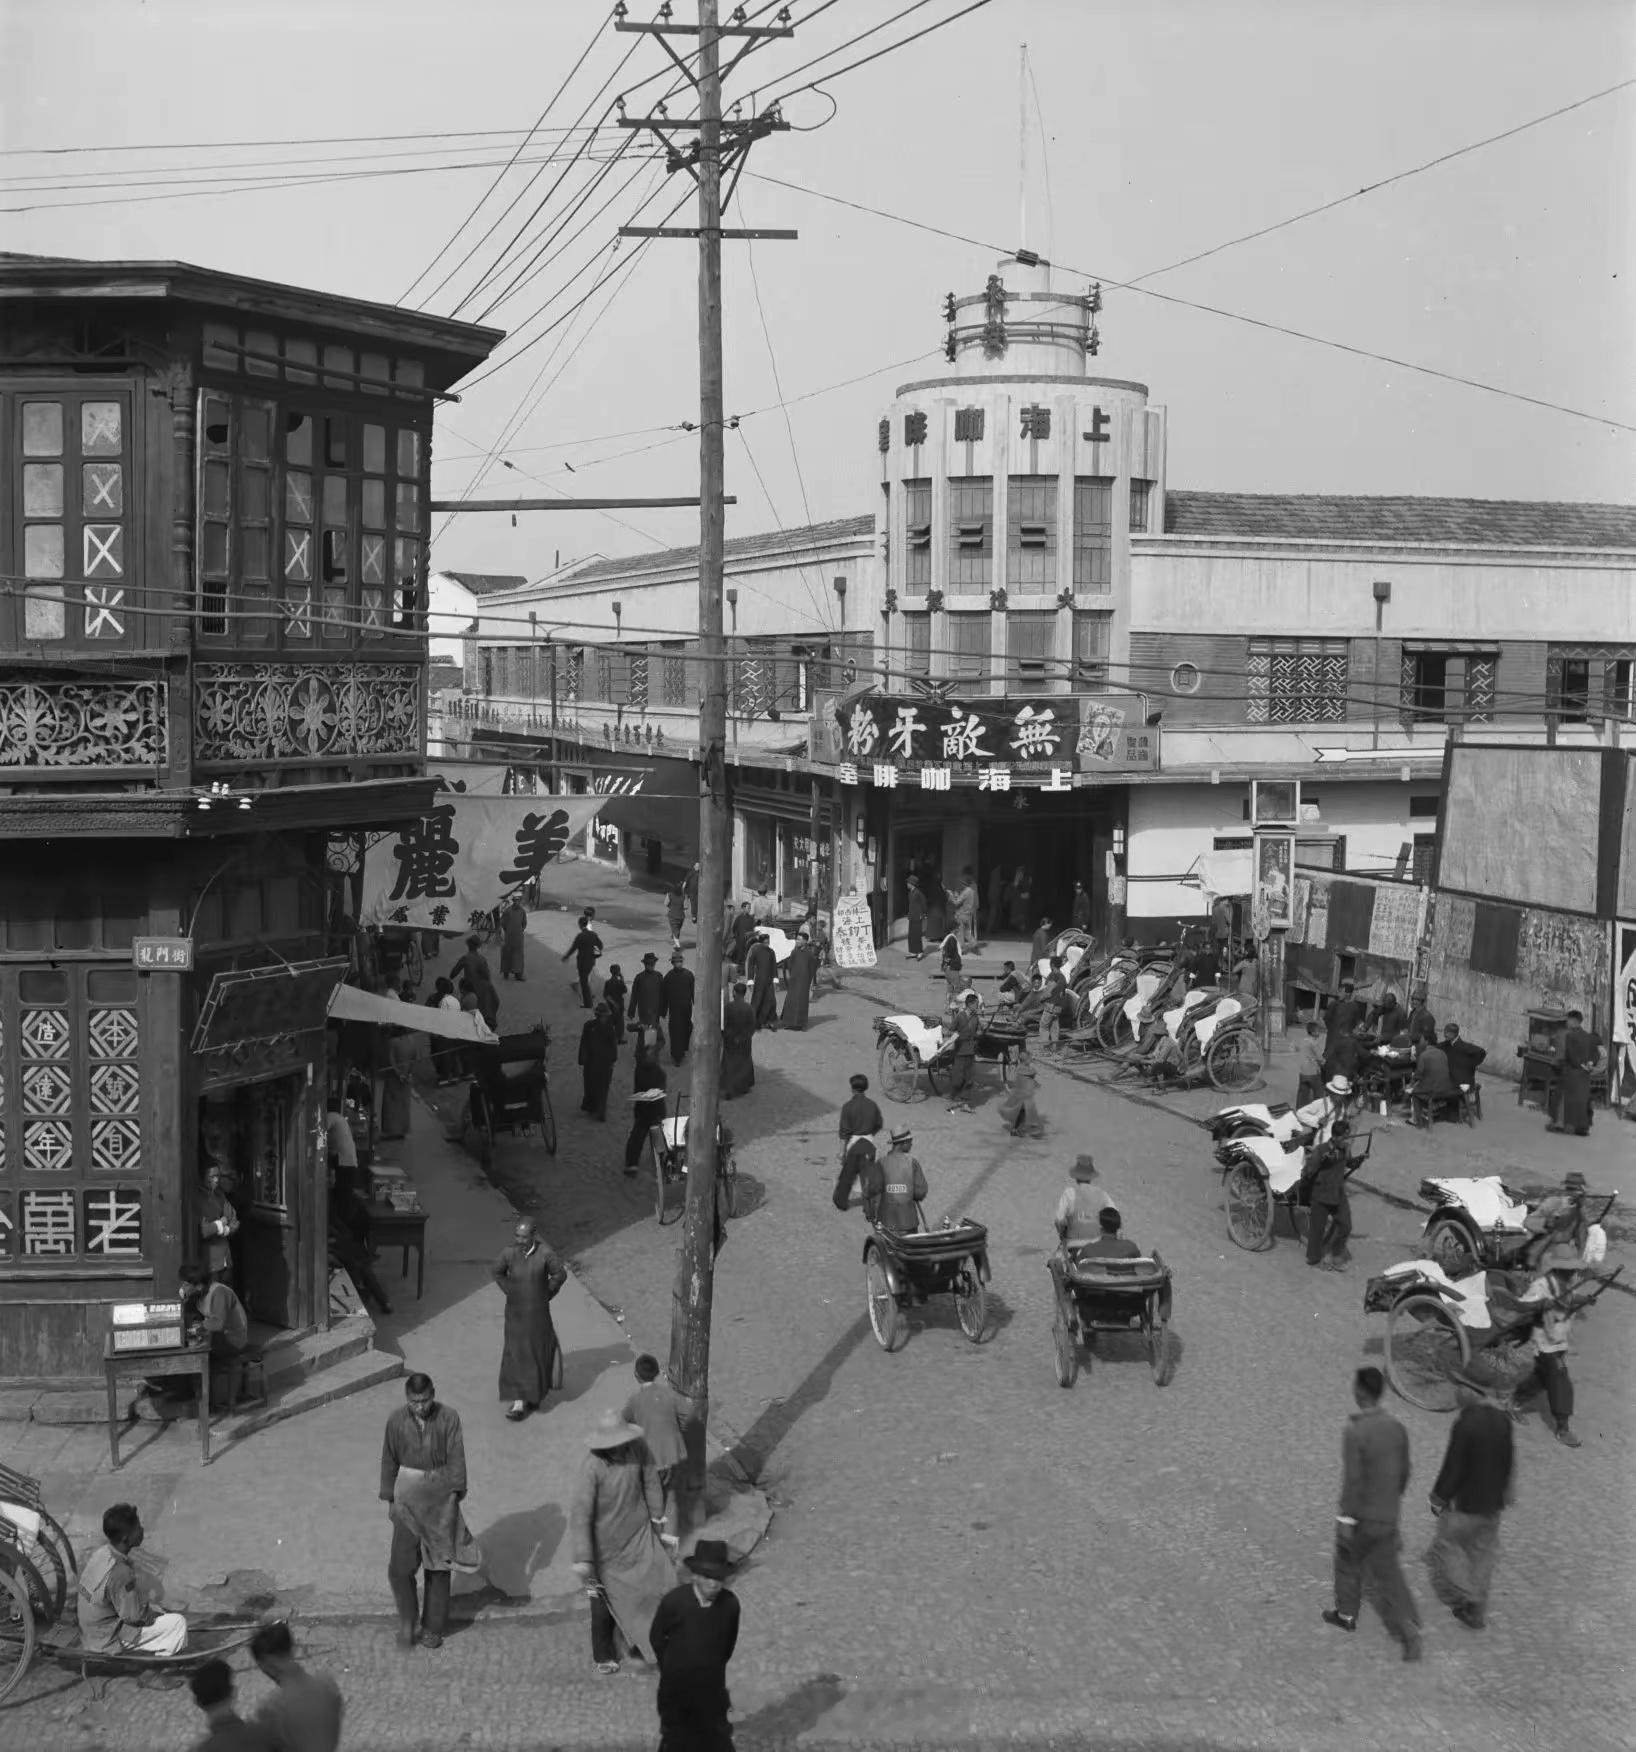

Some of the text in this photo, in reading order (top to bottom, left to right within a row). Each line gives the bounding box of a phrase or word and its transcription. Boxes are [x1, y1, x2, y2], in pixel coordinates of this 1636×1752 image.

[879, 405, 1110, 453] 上海咖啡室
[847, 703, 1061, 761] 無敵牙粉
[840, 762, 1072, 792] 上海咖啡室
[389, 803, 570, 902] 美麗
